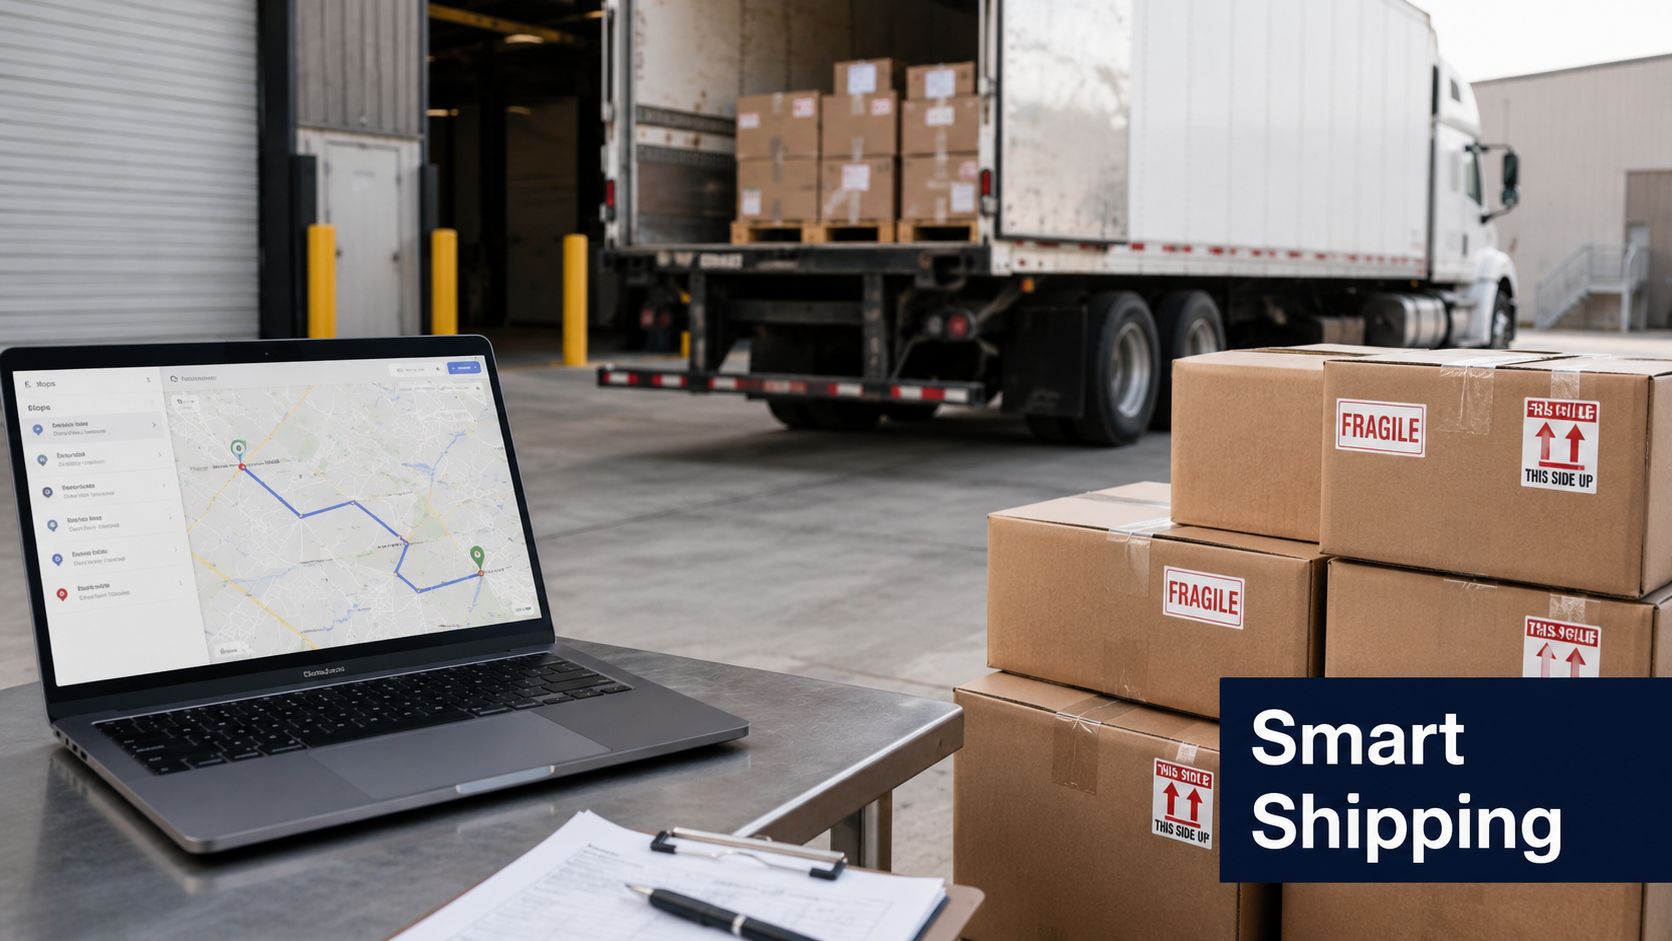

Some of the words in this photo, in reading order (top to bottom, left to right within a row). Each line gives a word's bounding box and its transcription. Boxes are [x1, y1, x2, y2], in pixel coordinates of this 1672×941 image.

[1342, 412, 1419, 443] FRAGILE
[1525, 468, 1548, 484] THIS
[1551, 471, 1575, 487] SIDE
[1579, 474, 1593, 488] UP
[1169, 580, 1239, 615] FRAGILE
[1155, 819, 1174, 835] THIS
[1176, 825, 1195, 841] SIDE
[1198, 831, 1210, 843] UP
